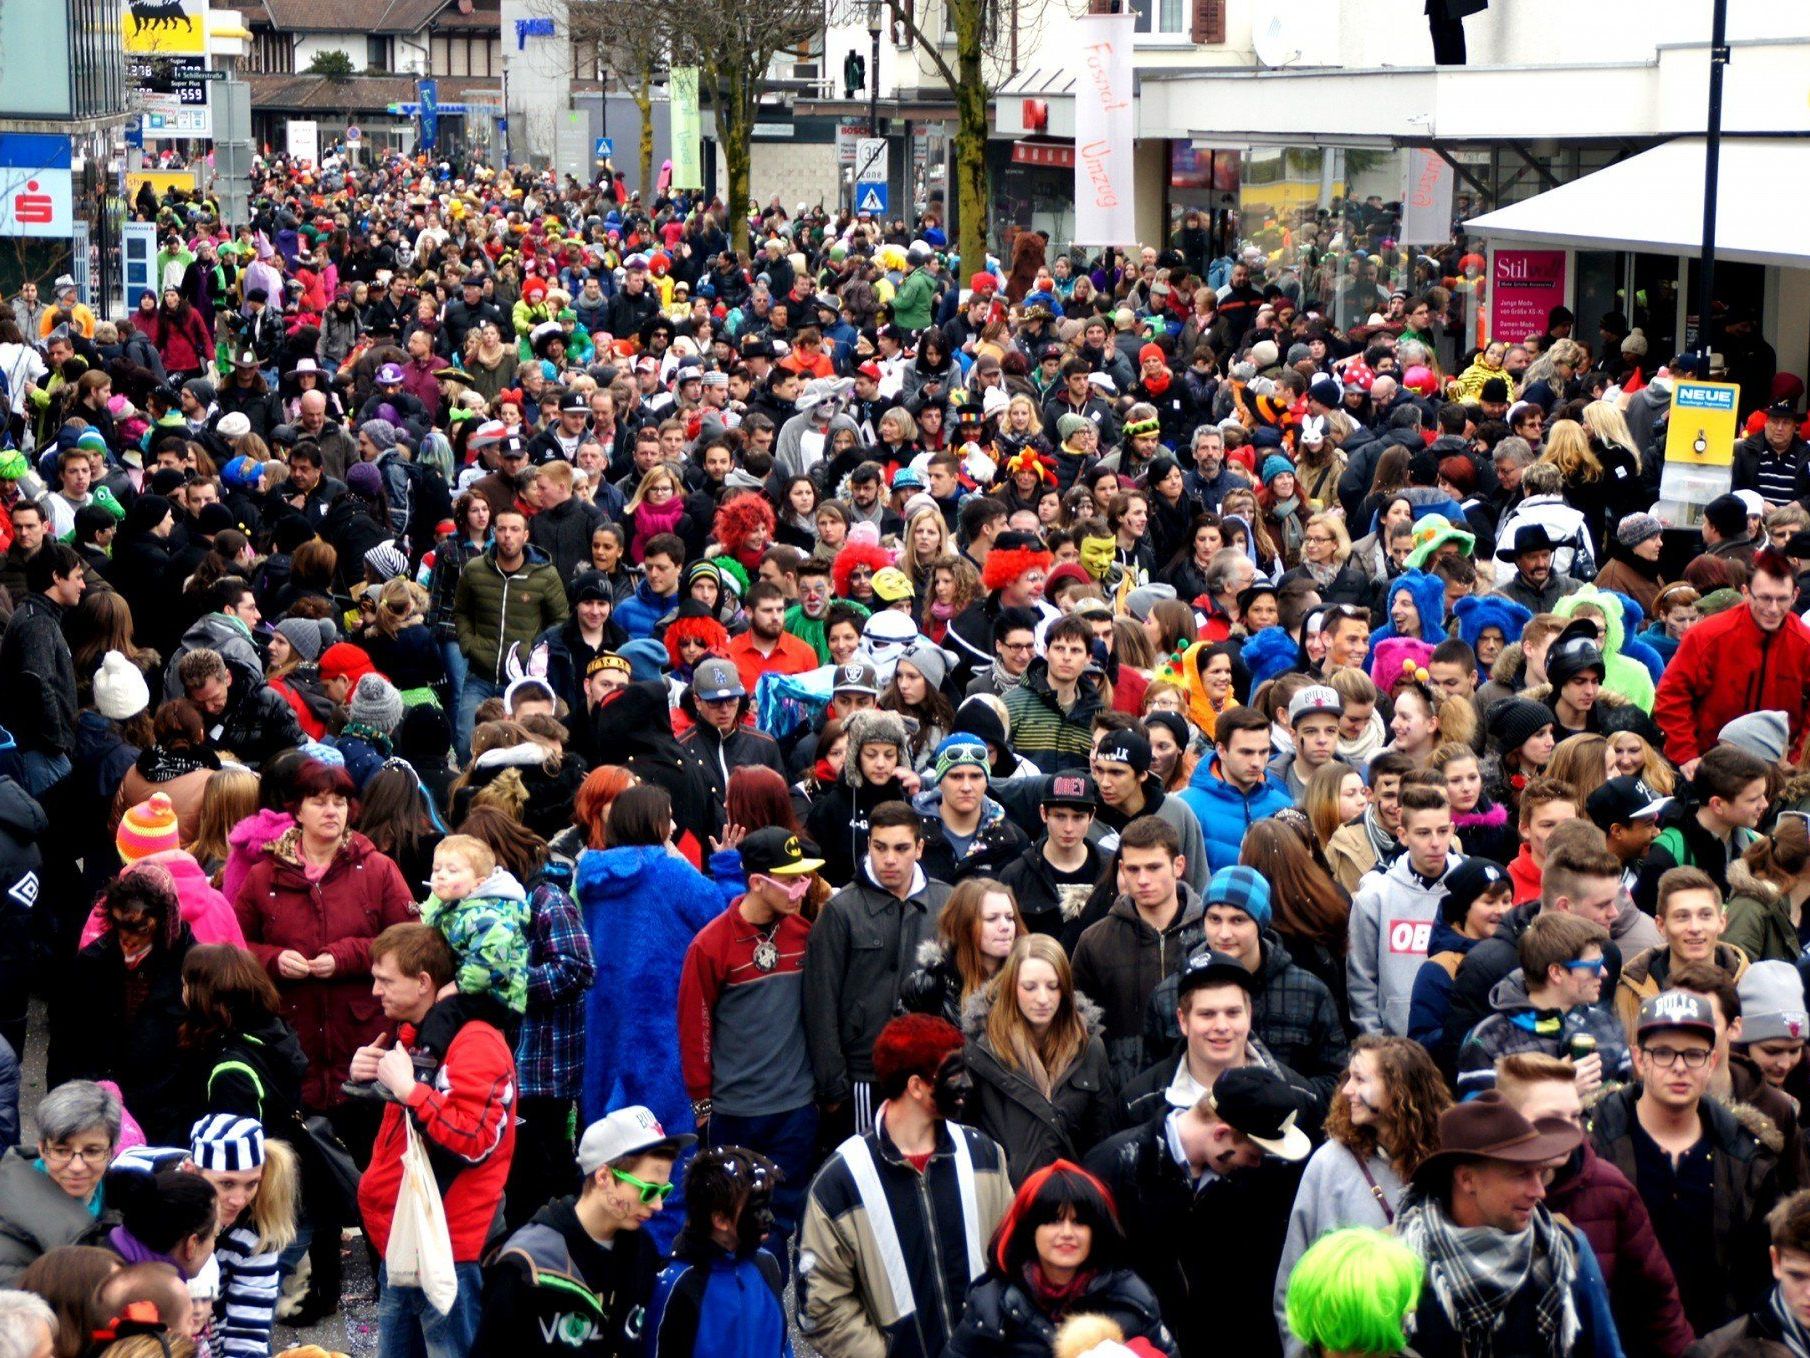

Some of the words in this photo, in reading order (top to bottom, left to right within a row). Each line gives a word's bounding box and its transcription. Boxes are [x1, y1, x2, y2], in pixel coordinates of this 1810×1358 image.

[169, 58, 187, 66] Super
[864, 146, 881, 161] 30
[1081, 140, 1118, 209] Umzug
[1500, 299, 1517, 307] Junge
[1680, 388, 1732, 402] NEUE
[1391, 922, 1432, 951] OB
[1655, 992, 1699, 1017] BULLS
